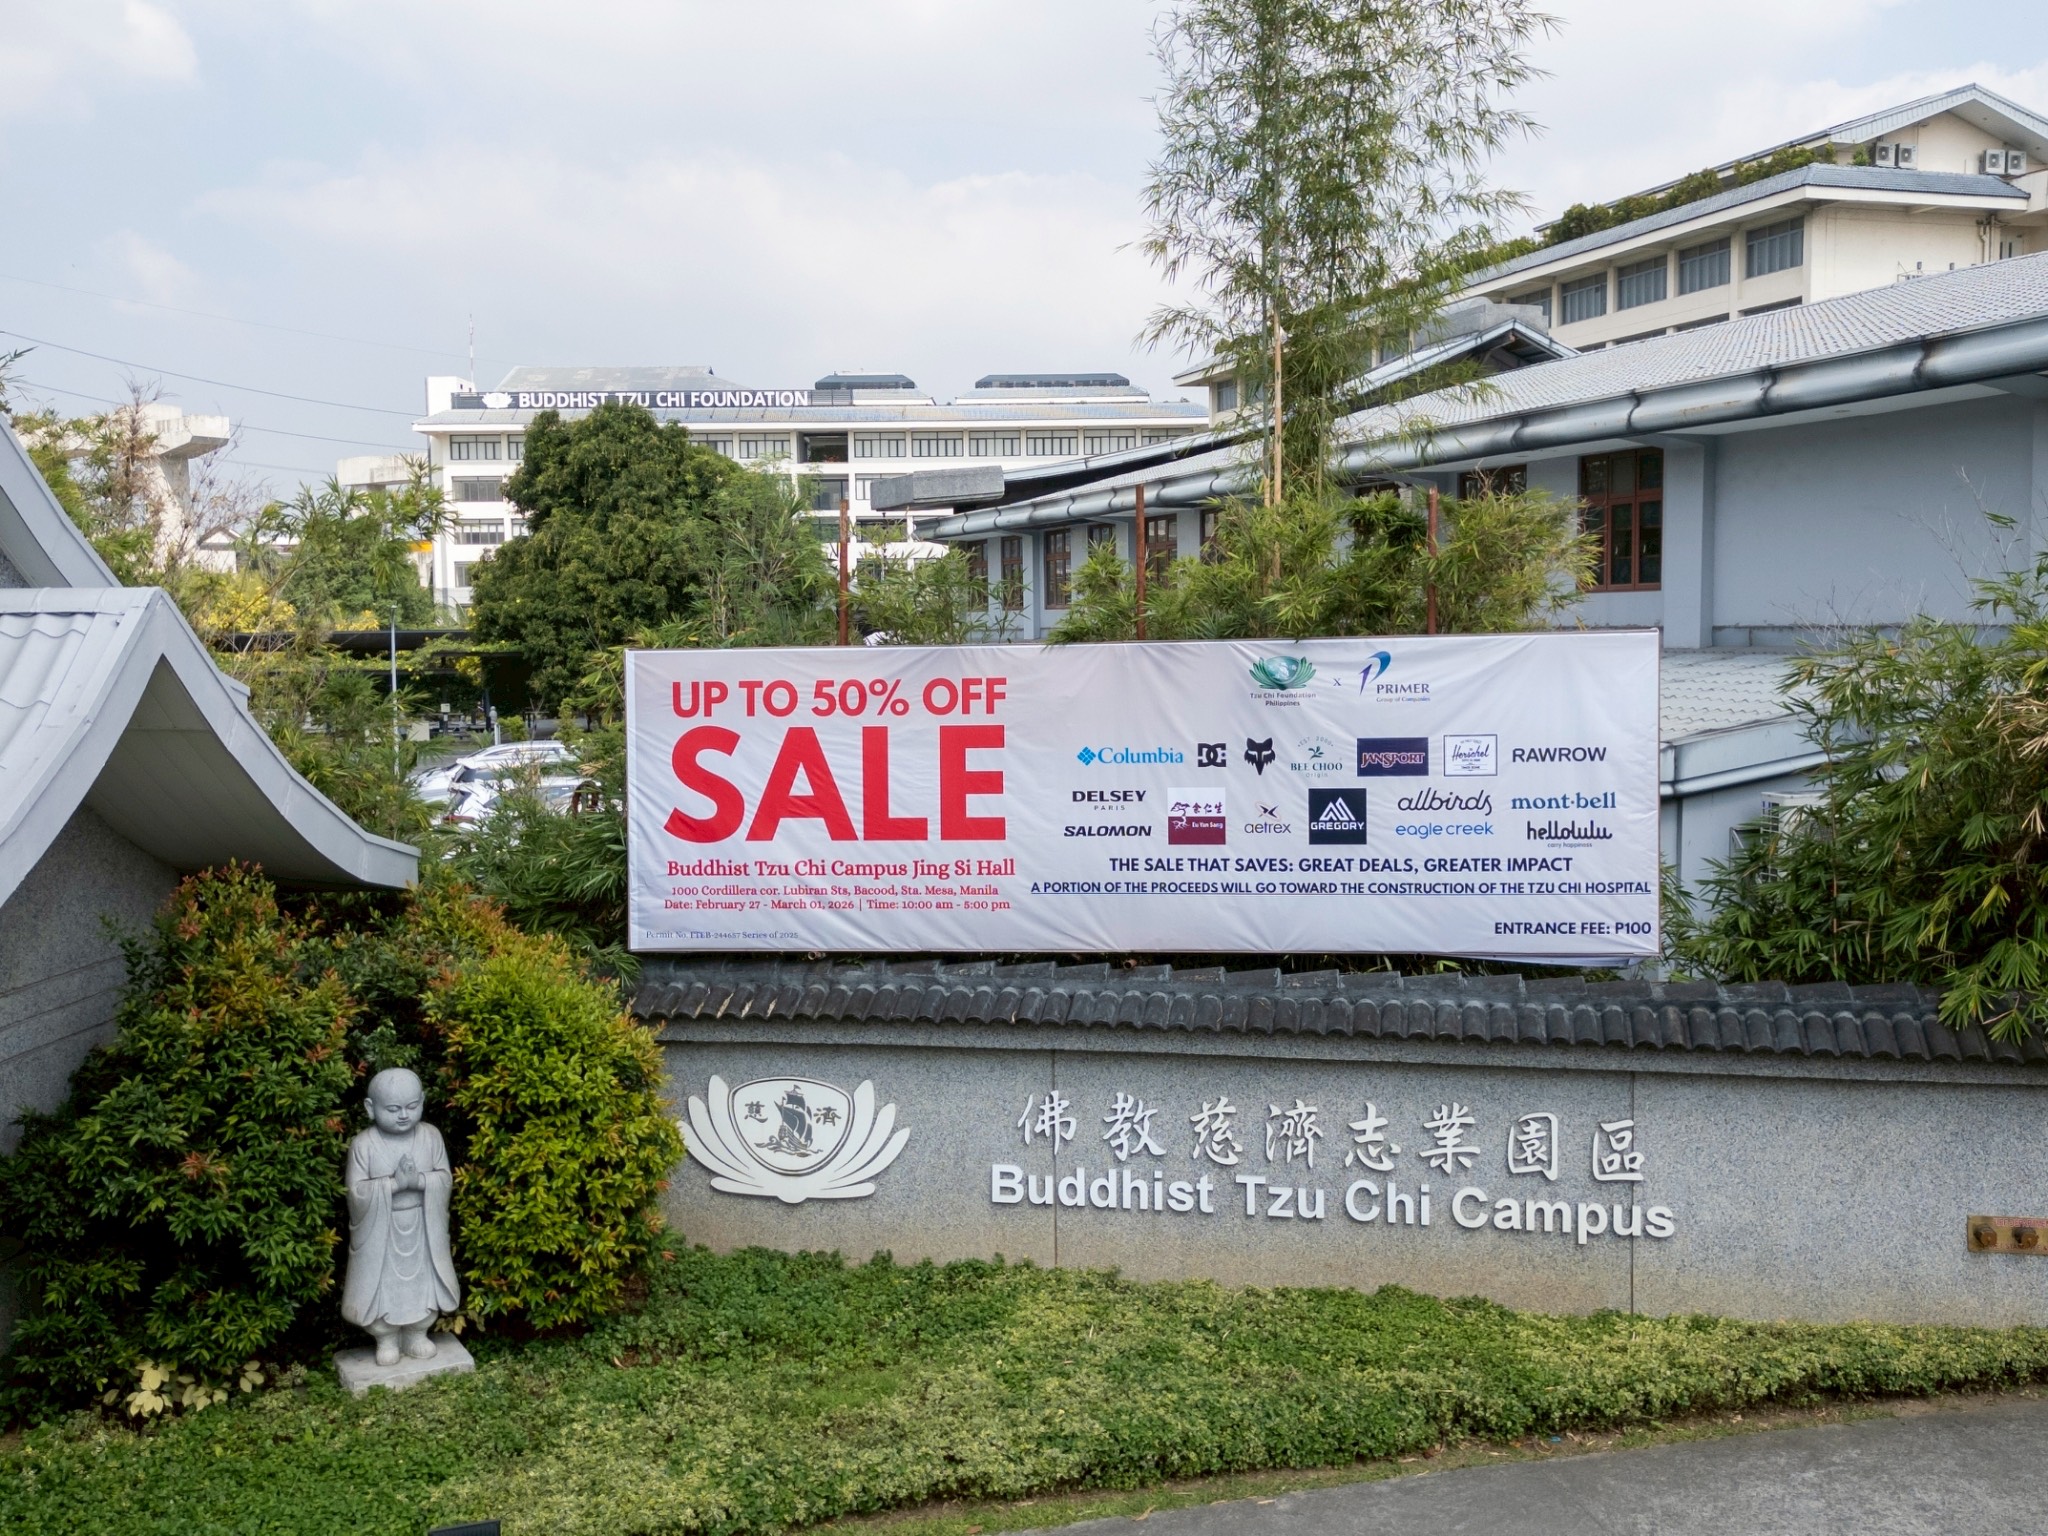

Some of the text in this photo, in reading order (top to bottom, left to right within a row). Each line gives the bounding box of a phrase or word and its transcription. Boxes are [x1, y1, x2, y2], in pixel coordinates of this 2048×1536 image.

[519, 392, 607, 407] BUDDHIST
[656, 392, 685, 407] CHI
[691, 391, 808, 407] FOUNDATION
[1377, 684, 1429, 694] PRIMER
[672, 678, 1007, 718] UP TO 50% OFF
[1098, 747, 1183, 764] Columbia
[1513, 747, 1606, 762] RAWROW
[663, 724, 1006, 843] SALE
[1072, 790, 1146, 801] DELSEY
[1398, 788, 1492, 816] allbirds
[1064, 826, 1152, 836] SALOMON
[1244, 821, 1291, 834] aetrex
[1311, 822, 1364, 830] GREGORY
[1396, 822, 1494, 839] eagle creek
[1527, 820, 1613, 840] hellolulu
[667, 859, 1015, 880] Buddhist Tzu Chi Campus Jing Si Hall
[1109, 858, 1573, 874] THE SALE THAT SAVES: GREAT DEALS, GREATER IMPACT
[672, 887, 698, 895] 1000
[702, 885, 757, 895] Cordillera
[784, 885, 827, 895] Lubiran
[831, 885, 850, 896] Sts,
[854, 885, 898, 896] Bacood,
[901, 886, 921, 895] Sta.
[925, 886, 956, 896] Mesa,
[960, 885, 999, 895] Manila
[1031, 882, 1651, 894] A PORTION OF THE PROCEEDS WILL GO TOWARD THE CONSTRUCTION OF THE TZU CHI HOSPITAL
[664, 900, 693, 909] Date:
[696, 900, 745, 911] February
[749, 901, 760, 909] 27
[771, 899, 807, 909] March
[810, 901, 824, 910] 01,
[829, 901, 854, 909] 2026
[867, 900, 899, 909] Time:
[902, 901, 932, 909] 10:00
[964, 901, 988, 909] 5:00
[991, 902, 1010, 911] pm
[1495, 922, 1651, 934] ENTRANCE FEE: P100
[1017, 1090, 1645, 1182] 佛教慈濟志業園區
[991, 1164, 1675, 1244] Buddhist Tzu Chi Campus
